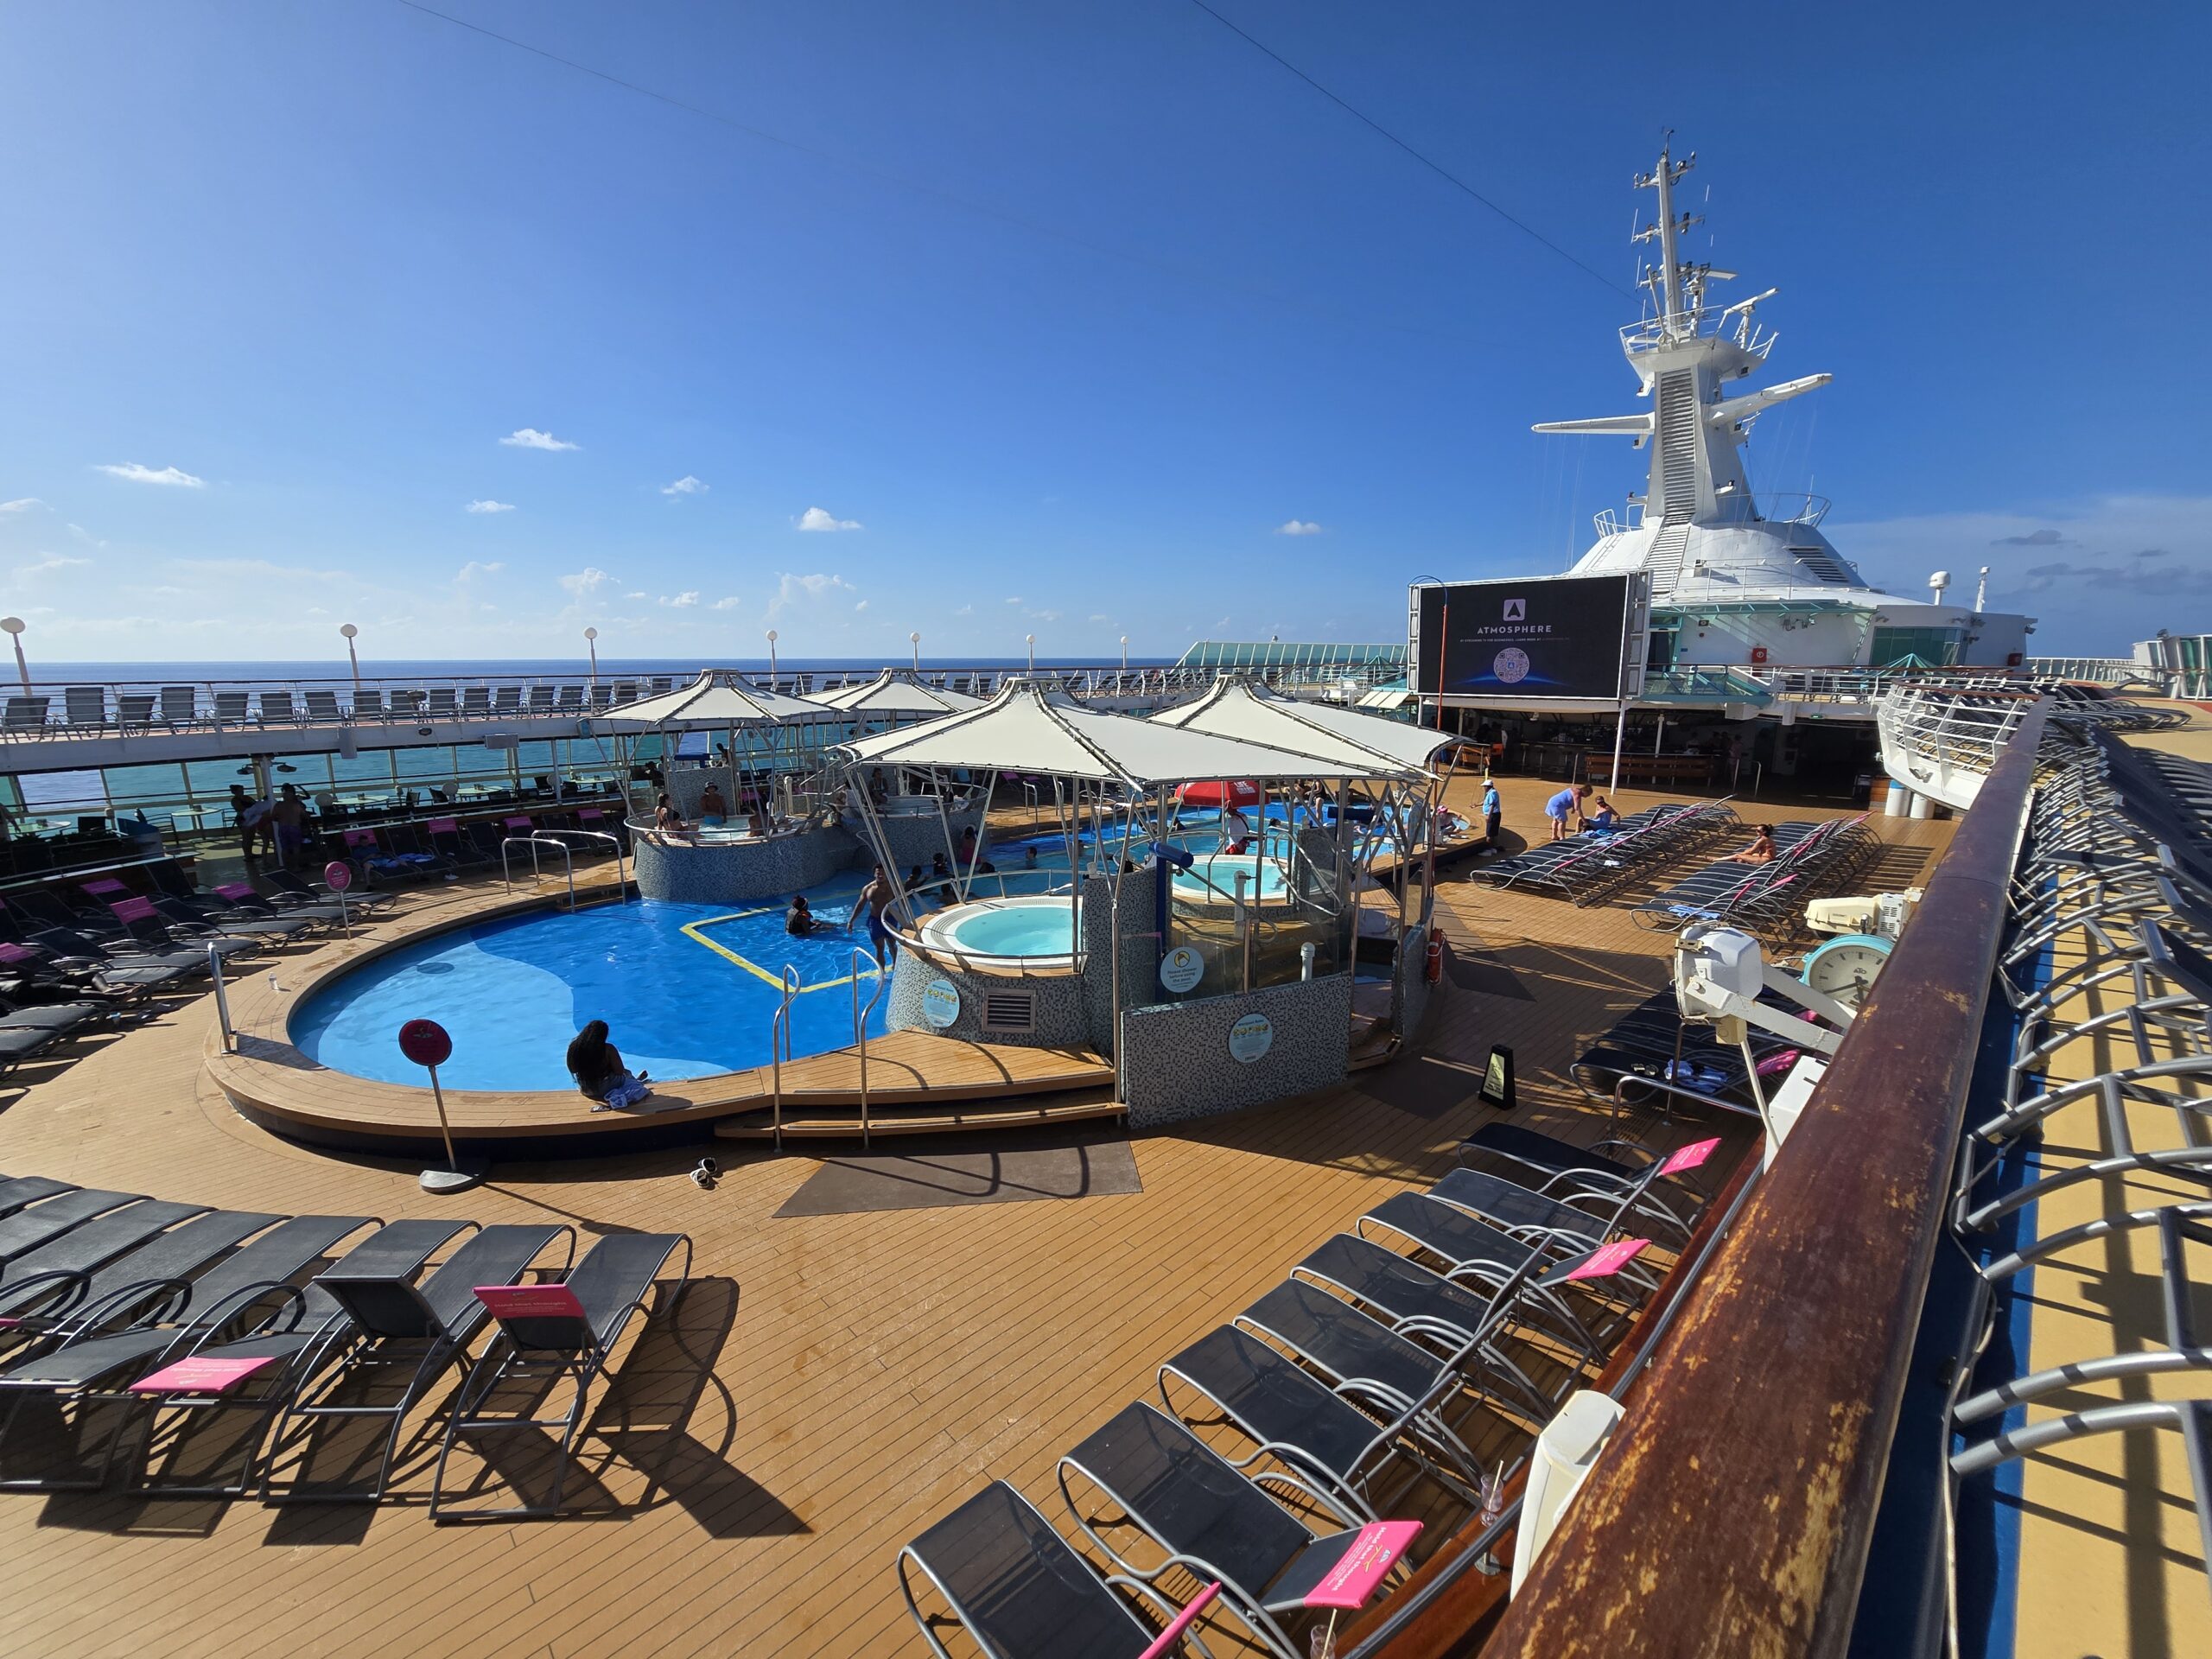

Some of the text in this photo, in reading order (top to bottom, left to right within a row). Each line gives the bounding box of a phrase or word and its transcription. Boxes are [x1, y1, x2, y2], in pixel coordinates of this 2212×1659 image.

[1477, 625, 1552, 634] ATMOSPHERE
[1332, 1527, 1387, 1592] Hold that thought
